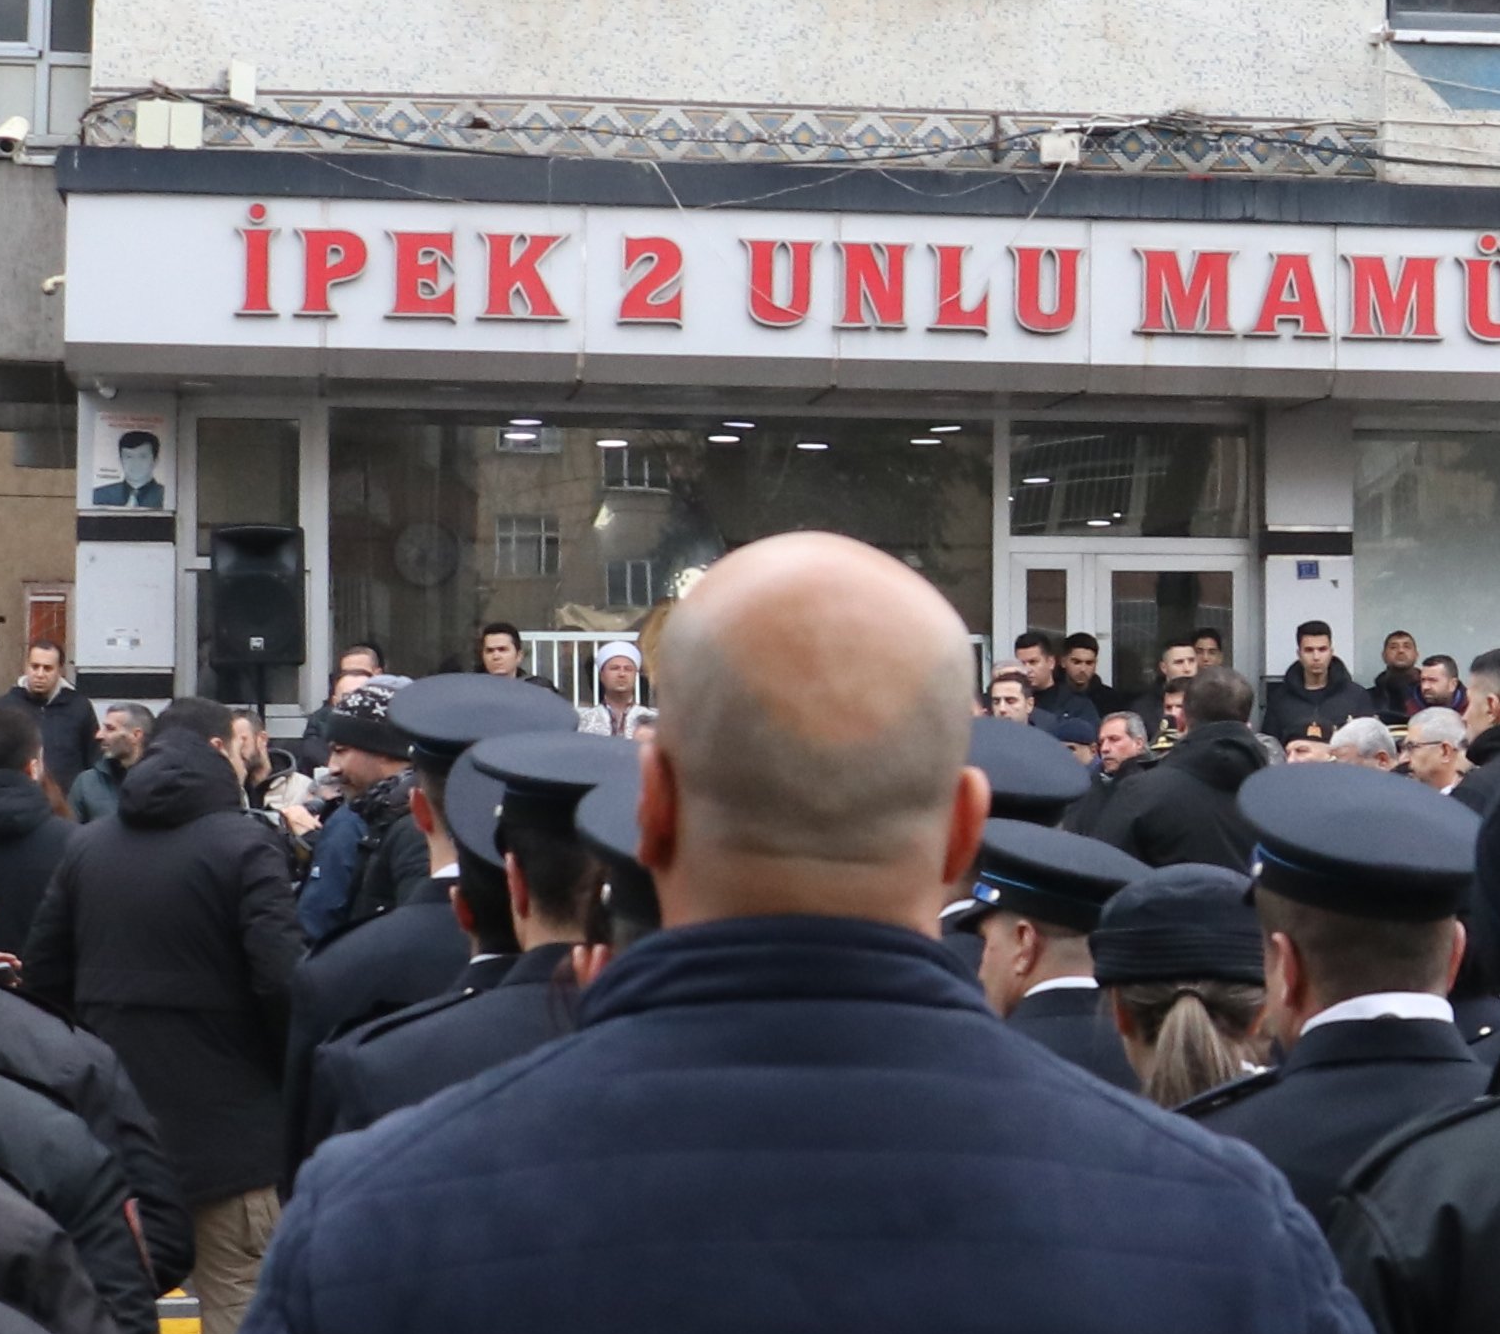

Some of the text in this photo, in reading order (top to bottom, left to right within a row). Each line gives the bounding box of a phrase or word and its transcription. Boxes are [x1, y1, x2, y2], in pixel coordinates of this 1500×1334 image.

[233, 203, 570, 323] İPEK
[617, 233, 683, 329] 2
[740, 238, 1086, 335] UNLU
